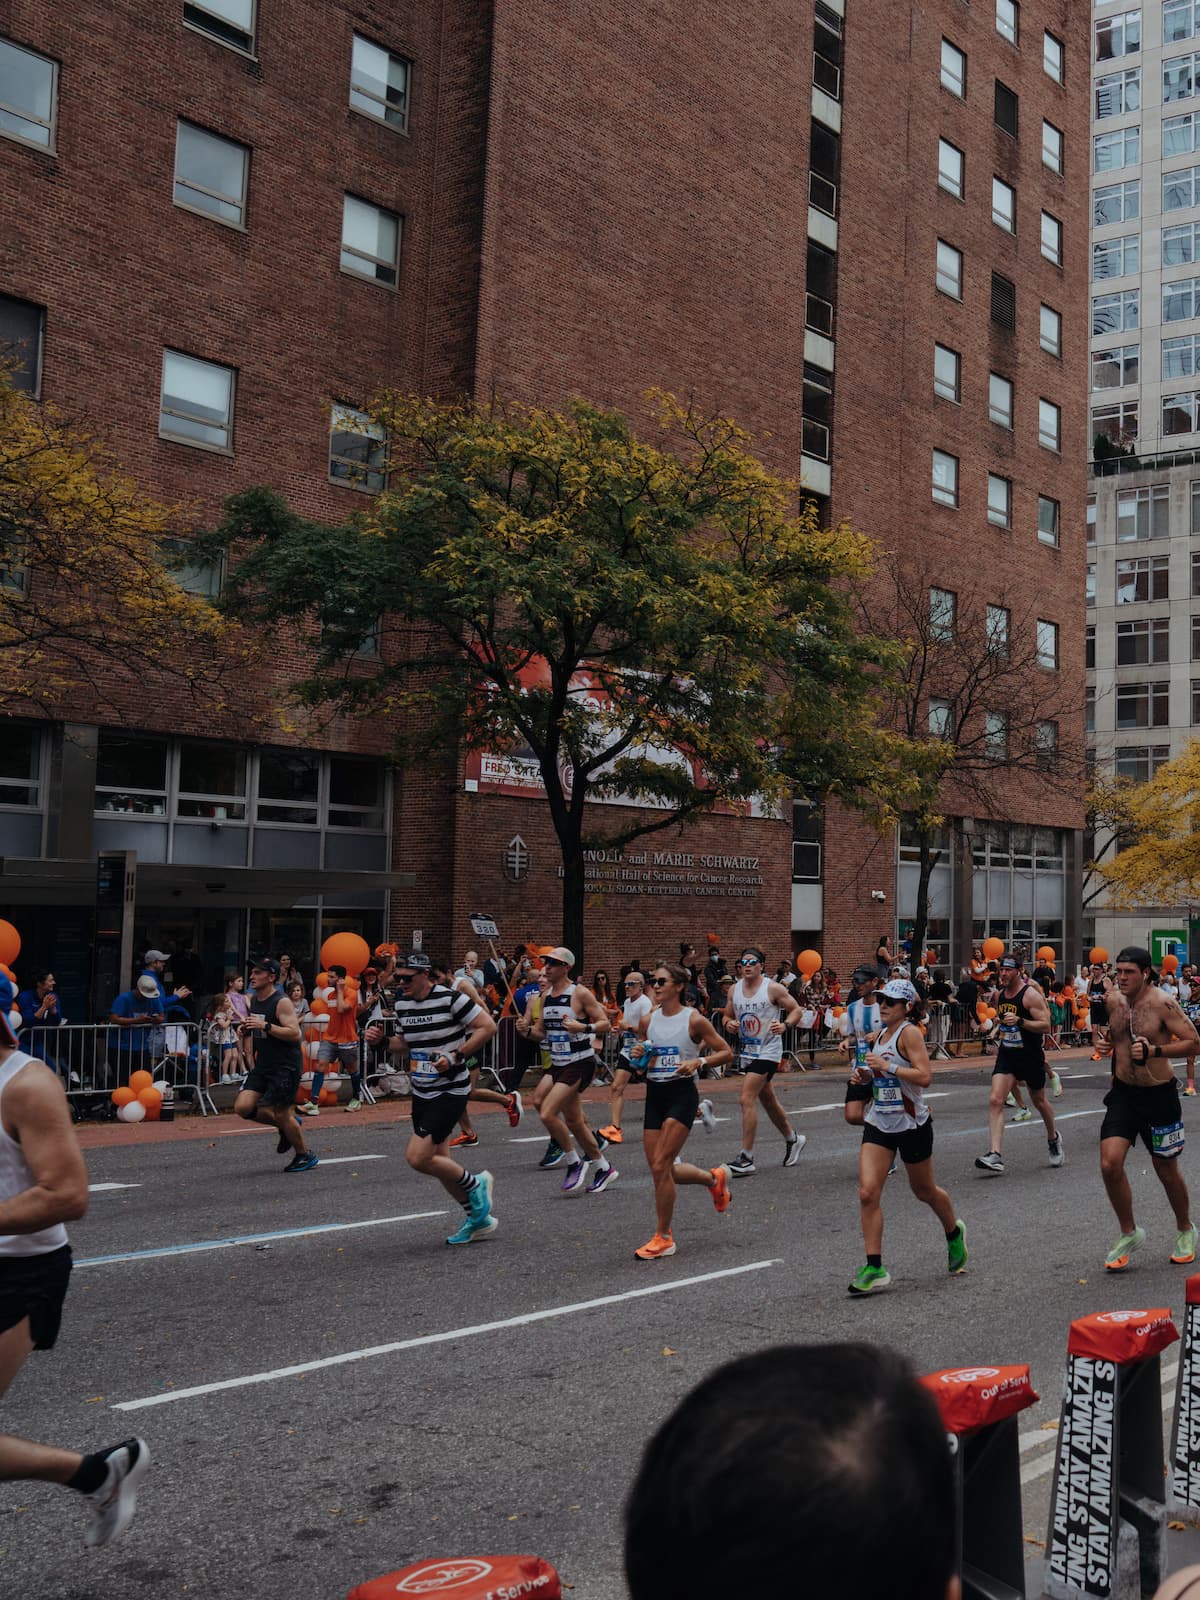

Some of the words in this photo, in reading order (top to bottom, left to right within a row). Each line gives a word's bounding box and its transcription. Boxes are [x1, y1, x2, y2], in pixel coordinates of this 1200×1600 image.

[583, 850, 622, 863] NOLD
[629, 852, 647, 864] and
[654, 852, 694, 867] MARIE
[700, 855, 759, 870] SCHWARTZ
[621, 869, 640, 881] Hall
[642, 870, 651, 881] of
[653, 871, 685, 883] Science
[686, 872, 699, 883] for
[700, 873, 728, 885] Cancer
[729, 874, 764, 886] Research
[981, 1384, 999, 1400] Out
[1000, 1379, 1009, 1391] of
[1071, 1357, 1095, 1455] AMAZIN
[1069, 1452, 1091, 1525] STAY
[1088, 1390, 1114, 1517] AMAZING
[1086, 1513, 1110, 1588] STAY
